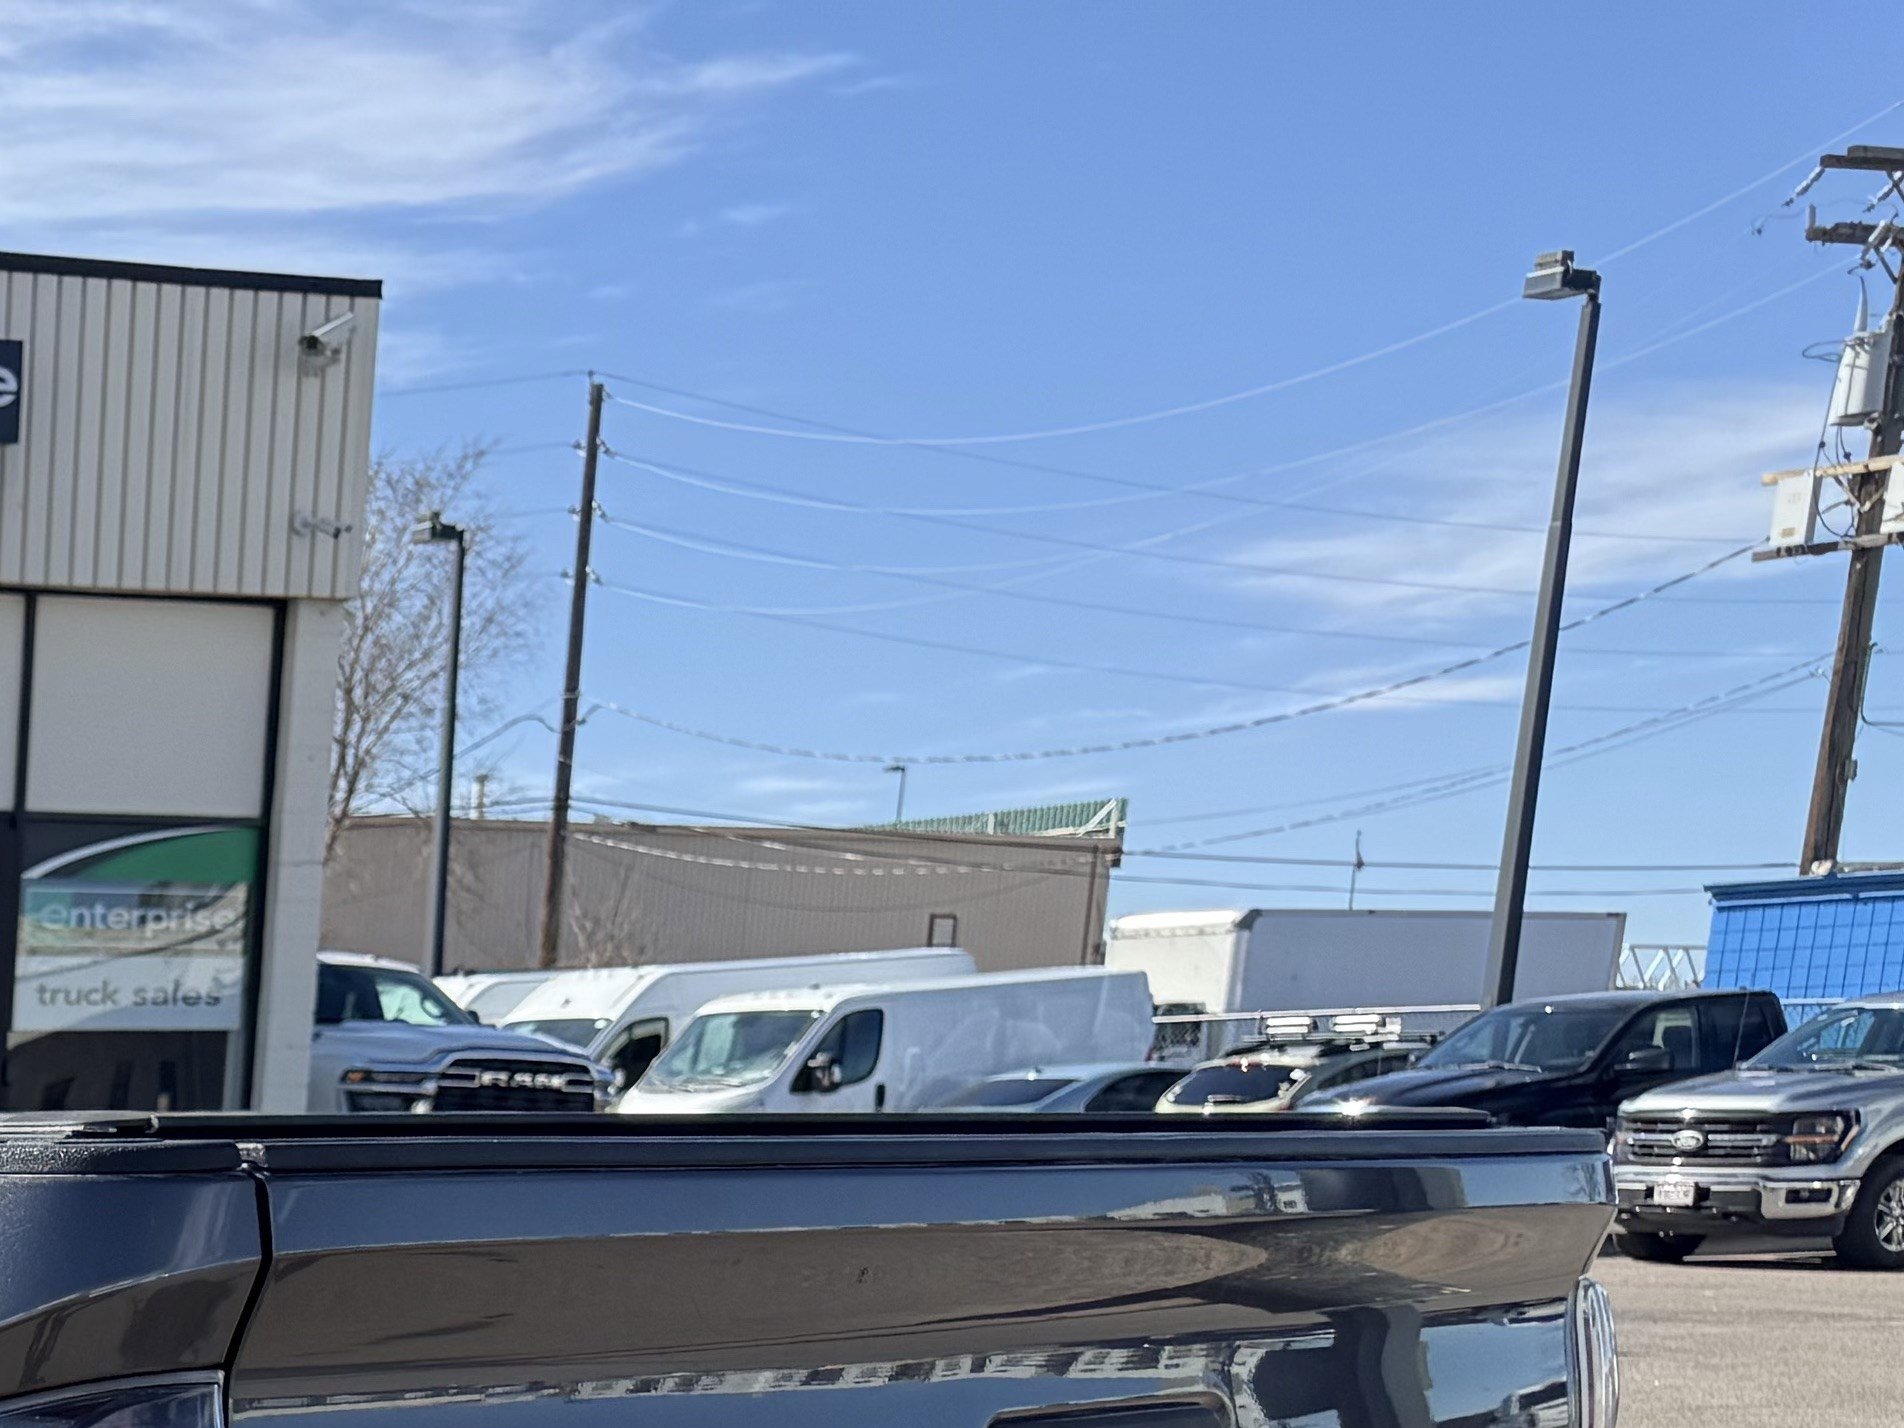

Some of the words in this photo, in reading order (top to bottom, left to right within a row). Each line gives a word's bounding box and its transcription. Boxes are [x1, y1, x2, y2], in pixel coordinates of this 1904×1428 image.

[39, 901, 241, 938] enterprise
[36, 978, 119, 1007] truck
[133, 978, 221, 1008] sales
